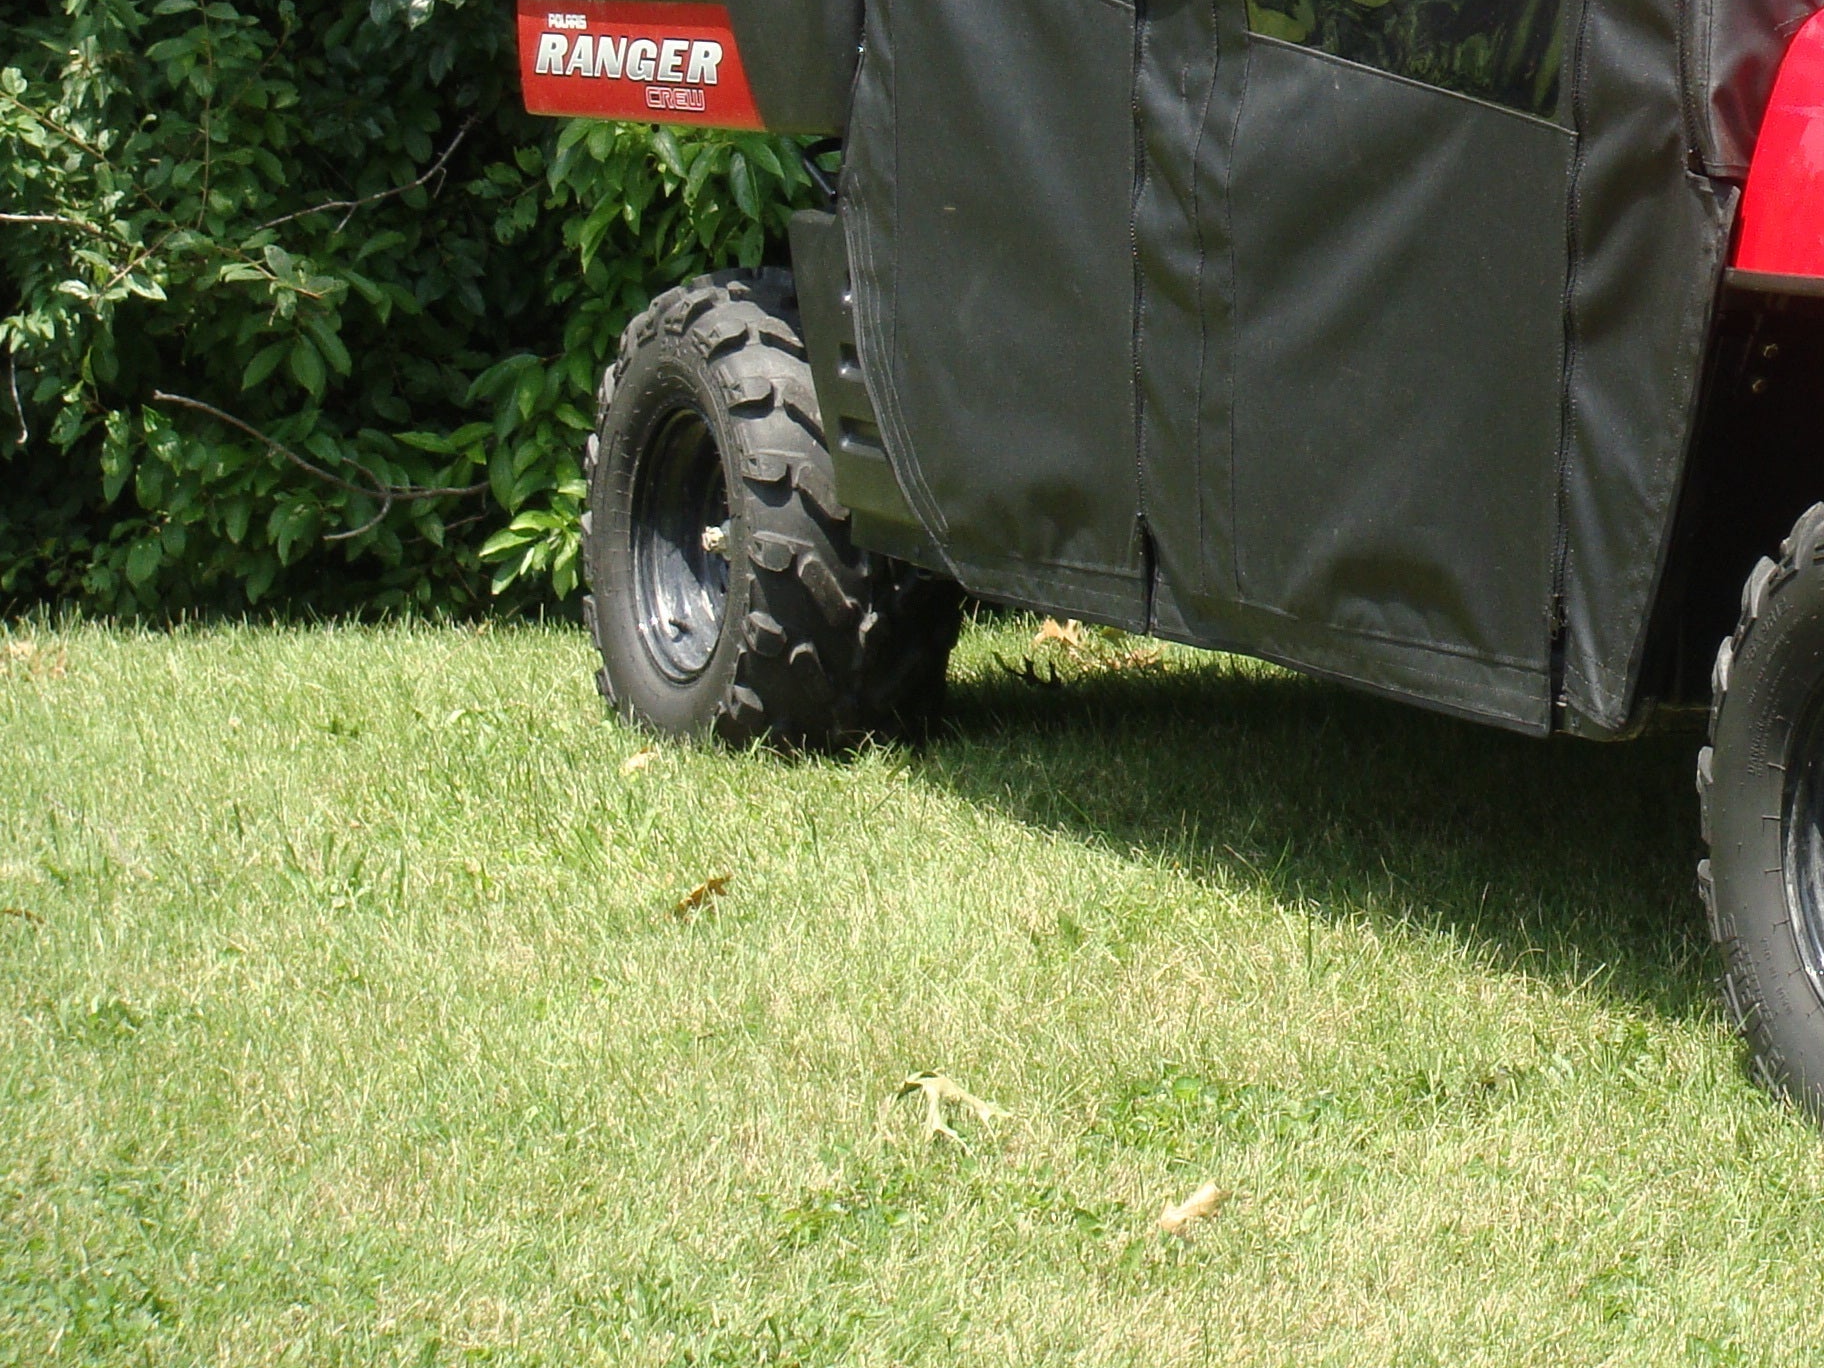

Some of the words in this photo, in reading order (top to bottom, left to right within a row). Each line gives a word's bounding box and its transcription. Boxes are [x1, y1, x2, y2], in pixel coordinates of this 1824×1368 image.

[547, 13, 588, 30] POLARIS
[534, 31, 724, 86] RANGER
[644, 85, 706, 112] CREW
